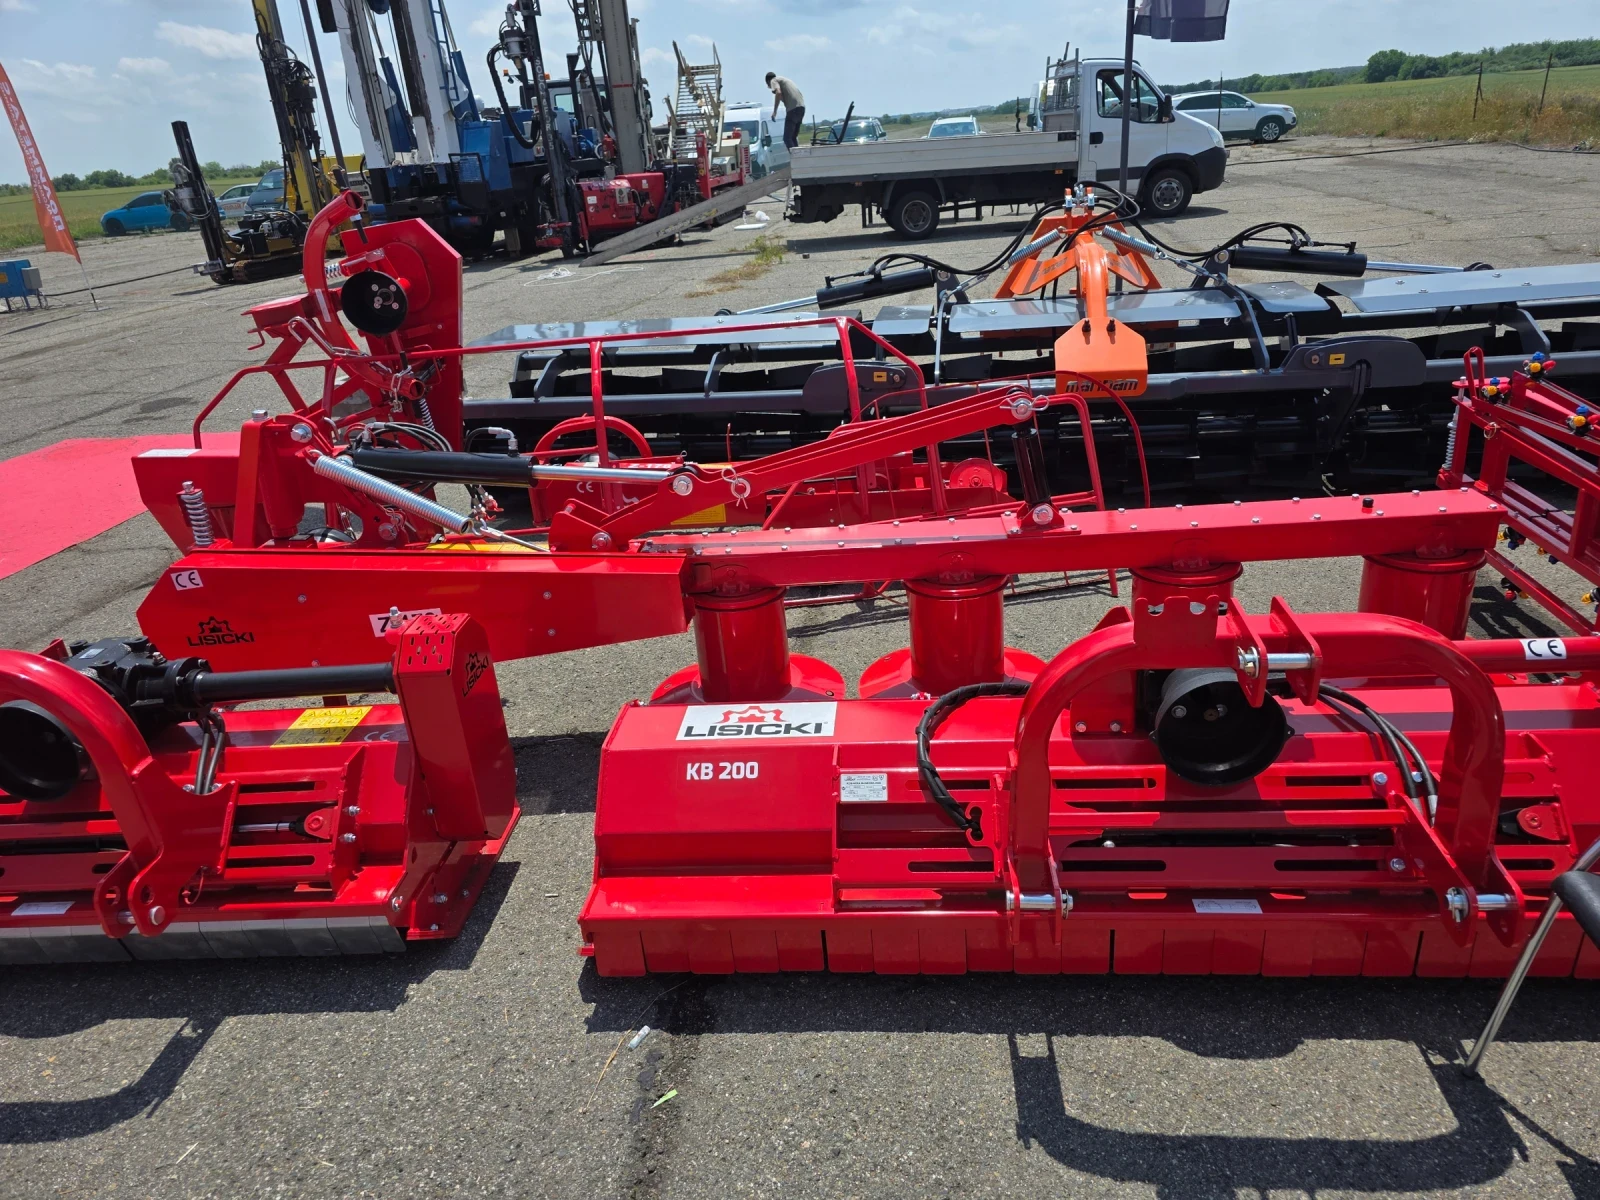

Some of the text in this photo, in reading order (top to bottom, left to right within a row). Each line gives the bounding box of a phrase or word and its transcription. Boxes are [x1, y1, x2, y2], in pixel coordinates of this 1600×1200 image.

[576, 481, 594, 493] CE
[175, 571, 200, 588] CE
[186, 632, 255, 647] LISICKI
[1527, 640, 1562, 657] CE
[462, 656, 489, 697] LISICKI
[364, 731, 395, 742] CE
[684, 722, 823, 737] LISICKI
[686, 761, 759, 781] KB 200
